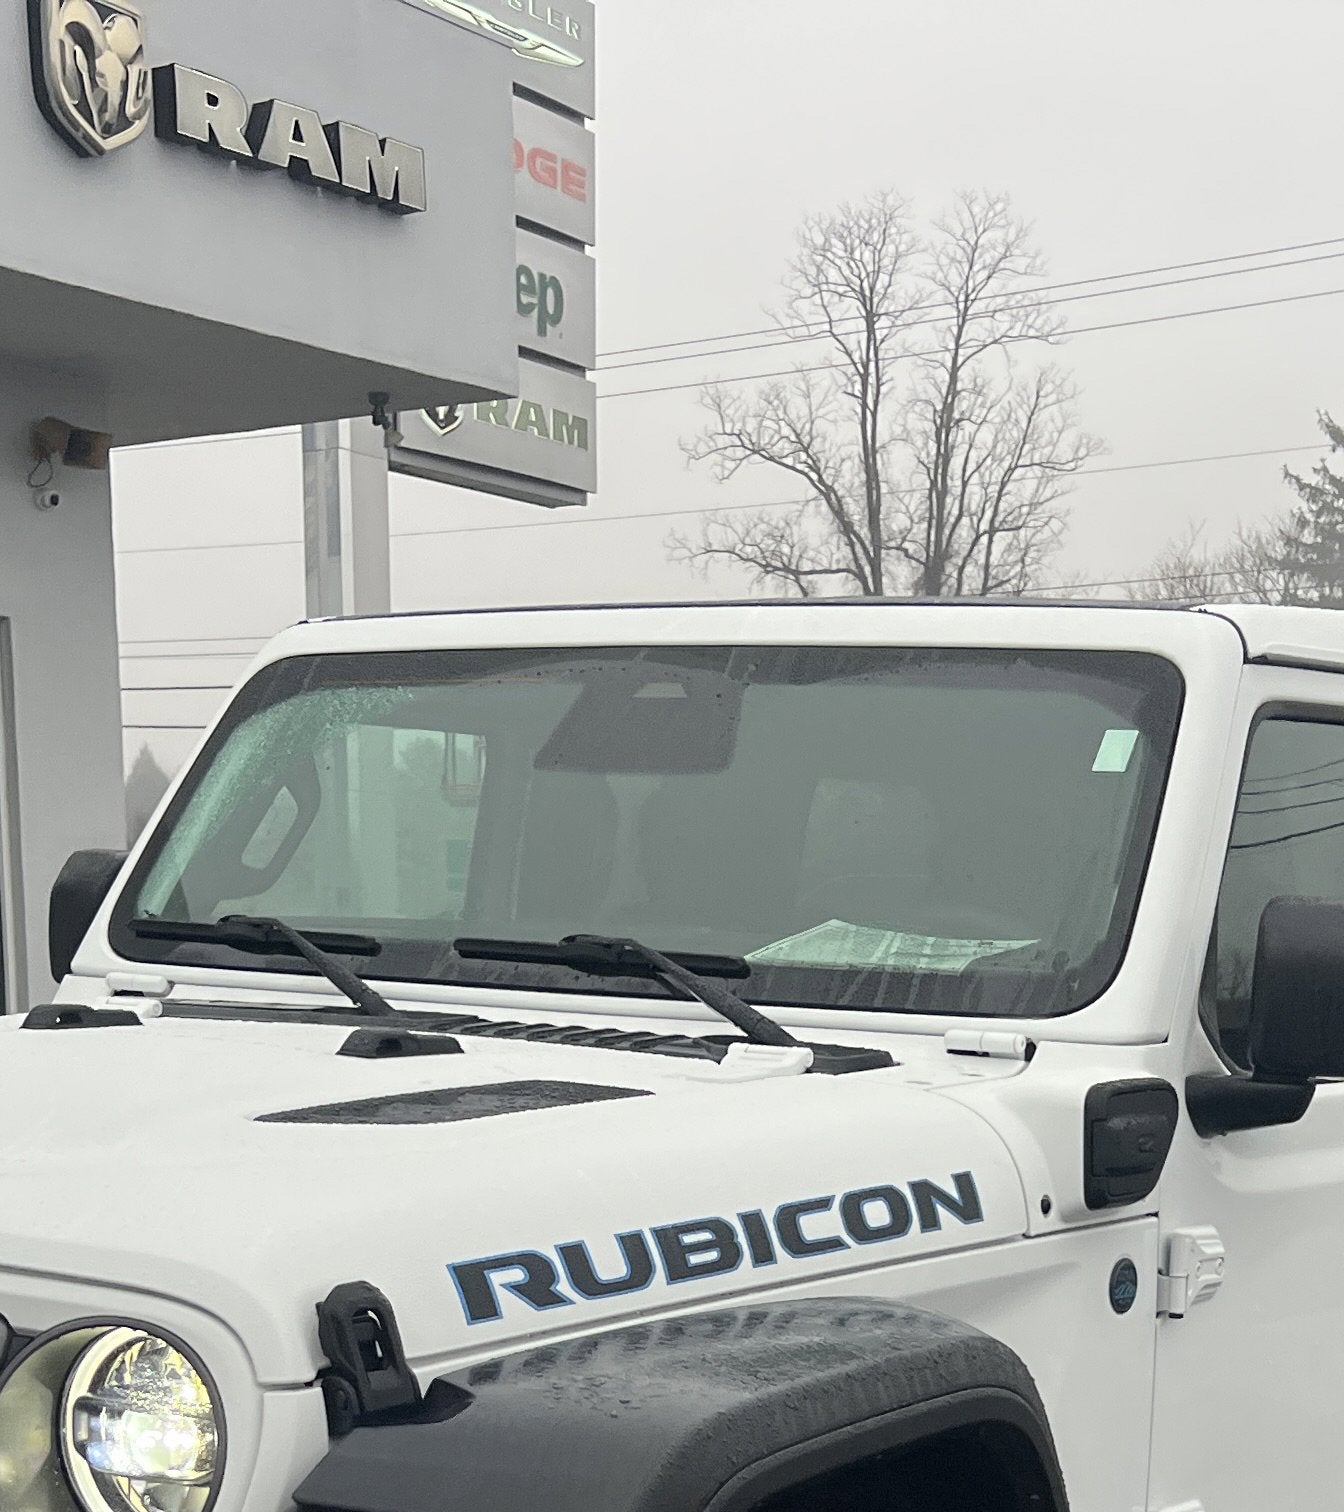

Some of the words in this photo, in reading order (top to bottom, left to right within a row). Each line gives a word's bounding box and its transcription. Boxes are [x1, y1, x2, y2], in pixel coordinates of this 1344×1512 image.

[161, 63, 427, 213] RAM
[515, 263, 564, 338] ep
[473, 399, 588, 452] RAM
[446, 1170, 984, 1326] RUBICON
